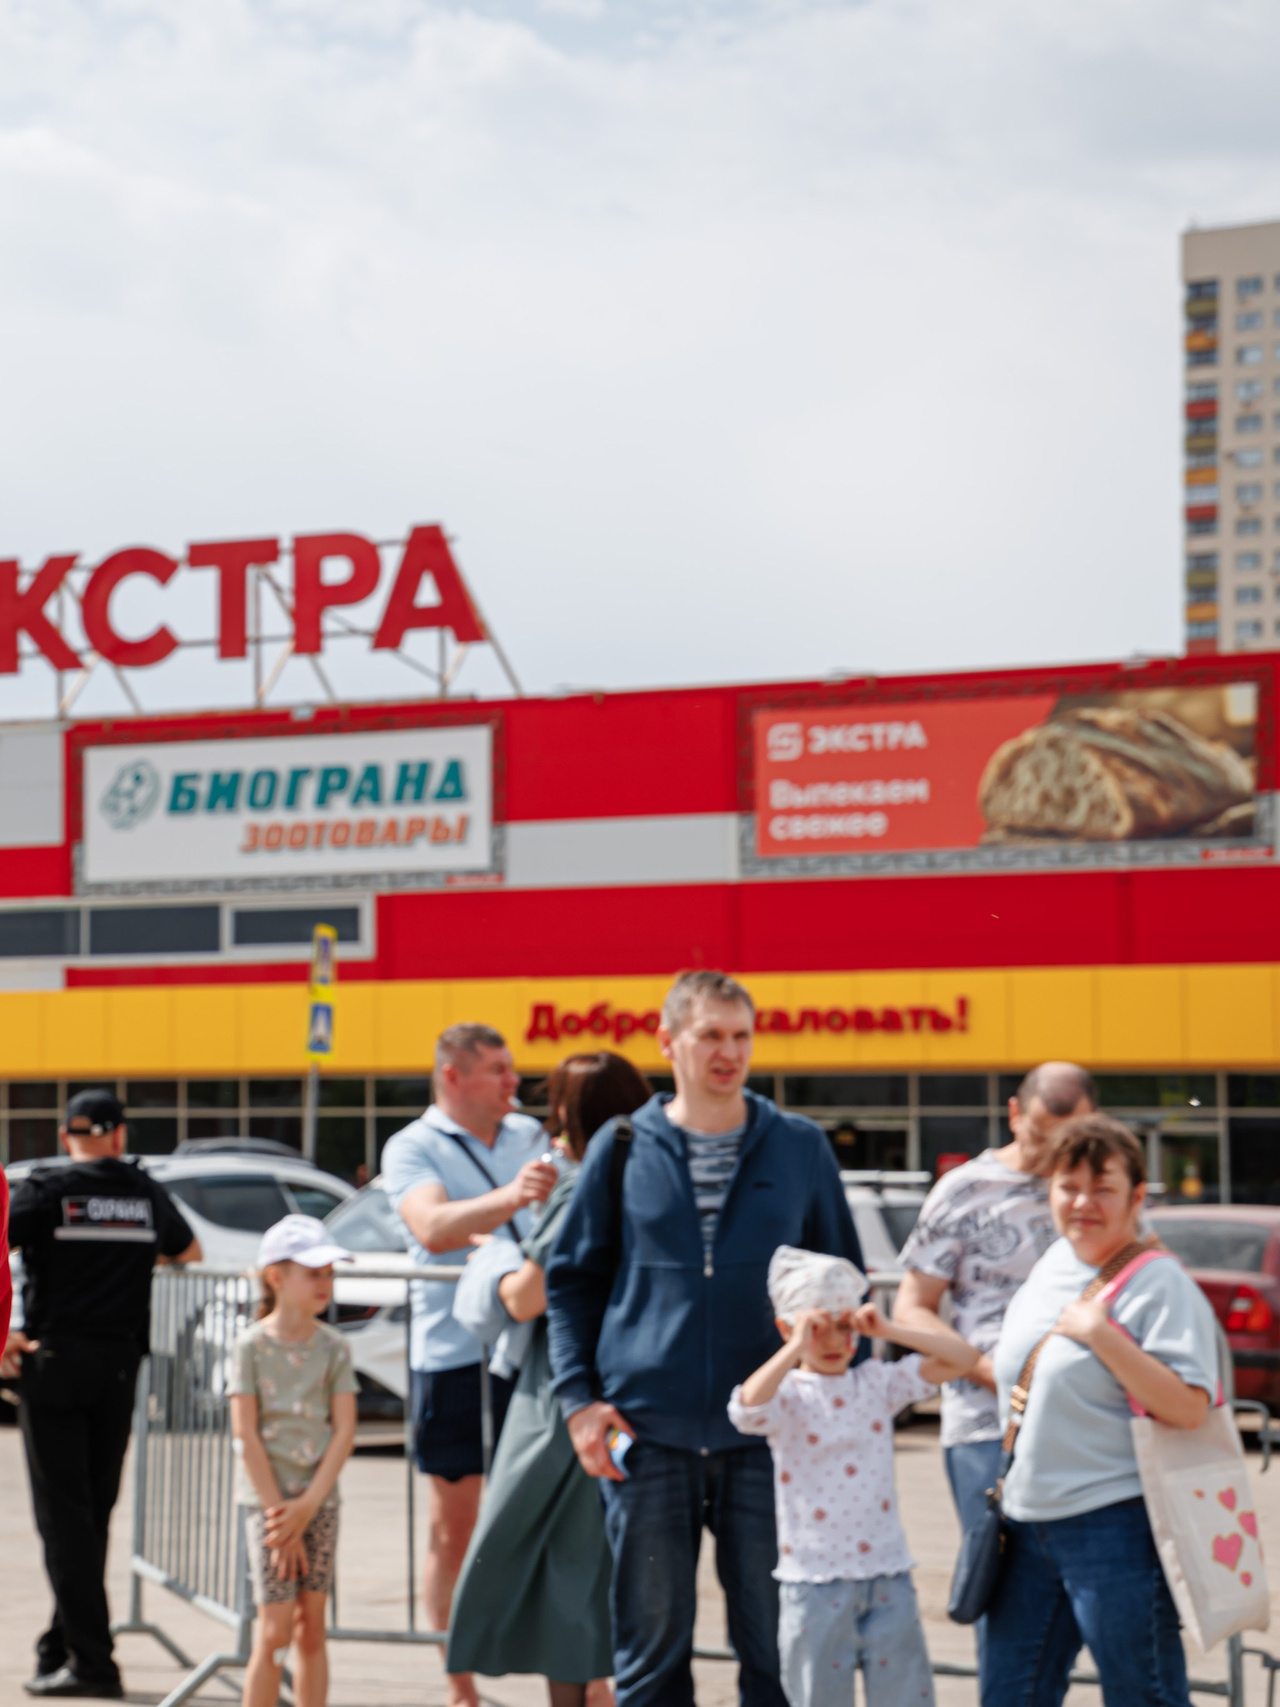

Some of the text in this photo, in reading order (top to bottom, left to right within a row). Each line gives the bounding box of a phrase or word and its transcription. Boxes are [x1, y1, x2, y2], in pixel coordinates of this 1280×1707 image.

[807, 721, 927, 755] ЭКСТРА
[770, 778, 929, 810] Выпекаем
[240, 815, 469, 853] ЗООТОВАРЫ
[770, 811, 888, 841] свежее
[526, 1000, 662, 1043] Добро
